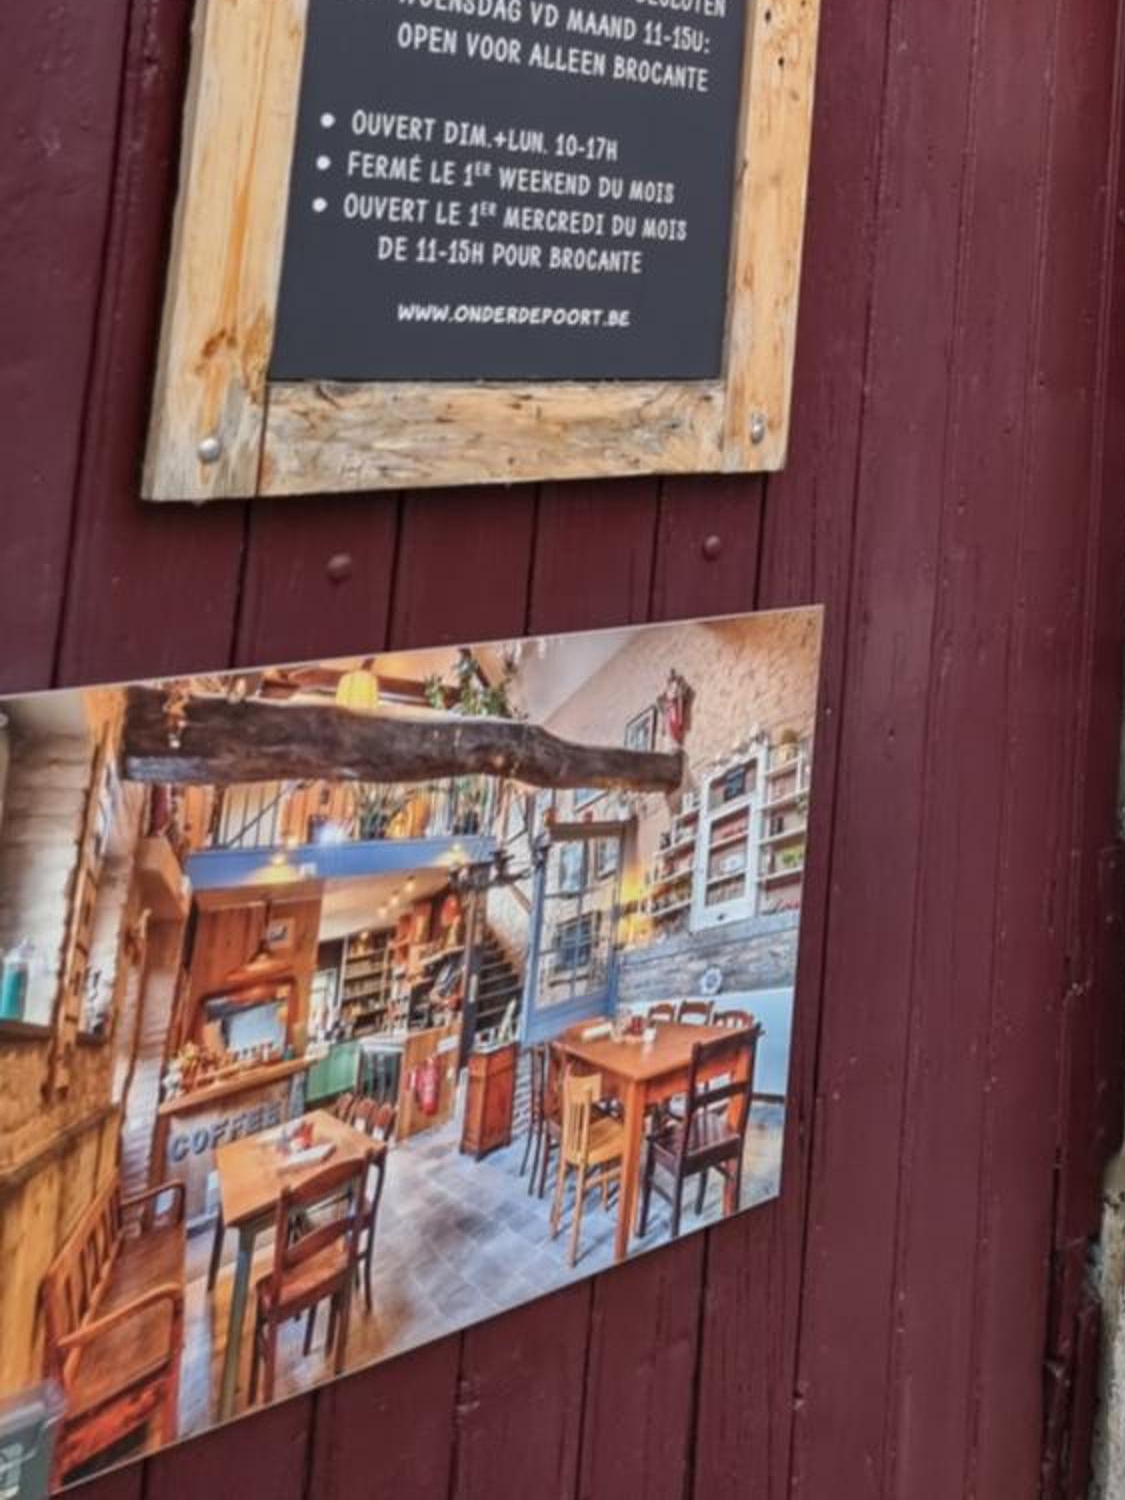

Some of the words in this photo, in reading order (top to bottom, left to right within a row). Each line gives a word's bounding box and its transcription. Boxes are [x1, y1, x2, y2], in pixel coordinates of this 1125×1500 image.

[530, 1, 559, 28] VD
[566, 8, 637, 41] MAAND
[643, 19, 711, 54] 11-15U:
[397, 21, 457, 56] OPEN
[466, 31, 521, 65] VOOR
[528, 42, 606, 77] ALLEEN
[613, 54, 709, 92] BROCANTE
[351, 108, 436, 142] OUVERT
[443, 120, 548, 155] DIM.+LUN.
[555, 132, 619, 161] 10-17H
[347, 150, 422, 182] FERMÉ
[430, 159, 456, 185] LE
[498, 166, 591, 197] WEEKEND
[598, 176, 624, 199] DU
[629, 179, 675, 204] MOIS
[343, 192, 429, 223] OUVERT
[435, 201, 461, 226] LE
[503, 206, 605, 236] MERCREDI
[611, 214, 637, 238] DU
[641, 217, 687, 241] MOIS
[378, 235, 408, 261] DE
[416, 237, 485, 264] 11-15H
[492, 242, 542, 268] POUR
[549, 246, 642, 275] BROCANTE
